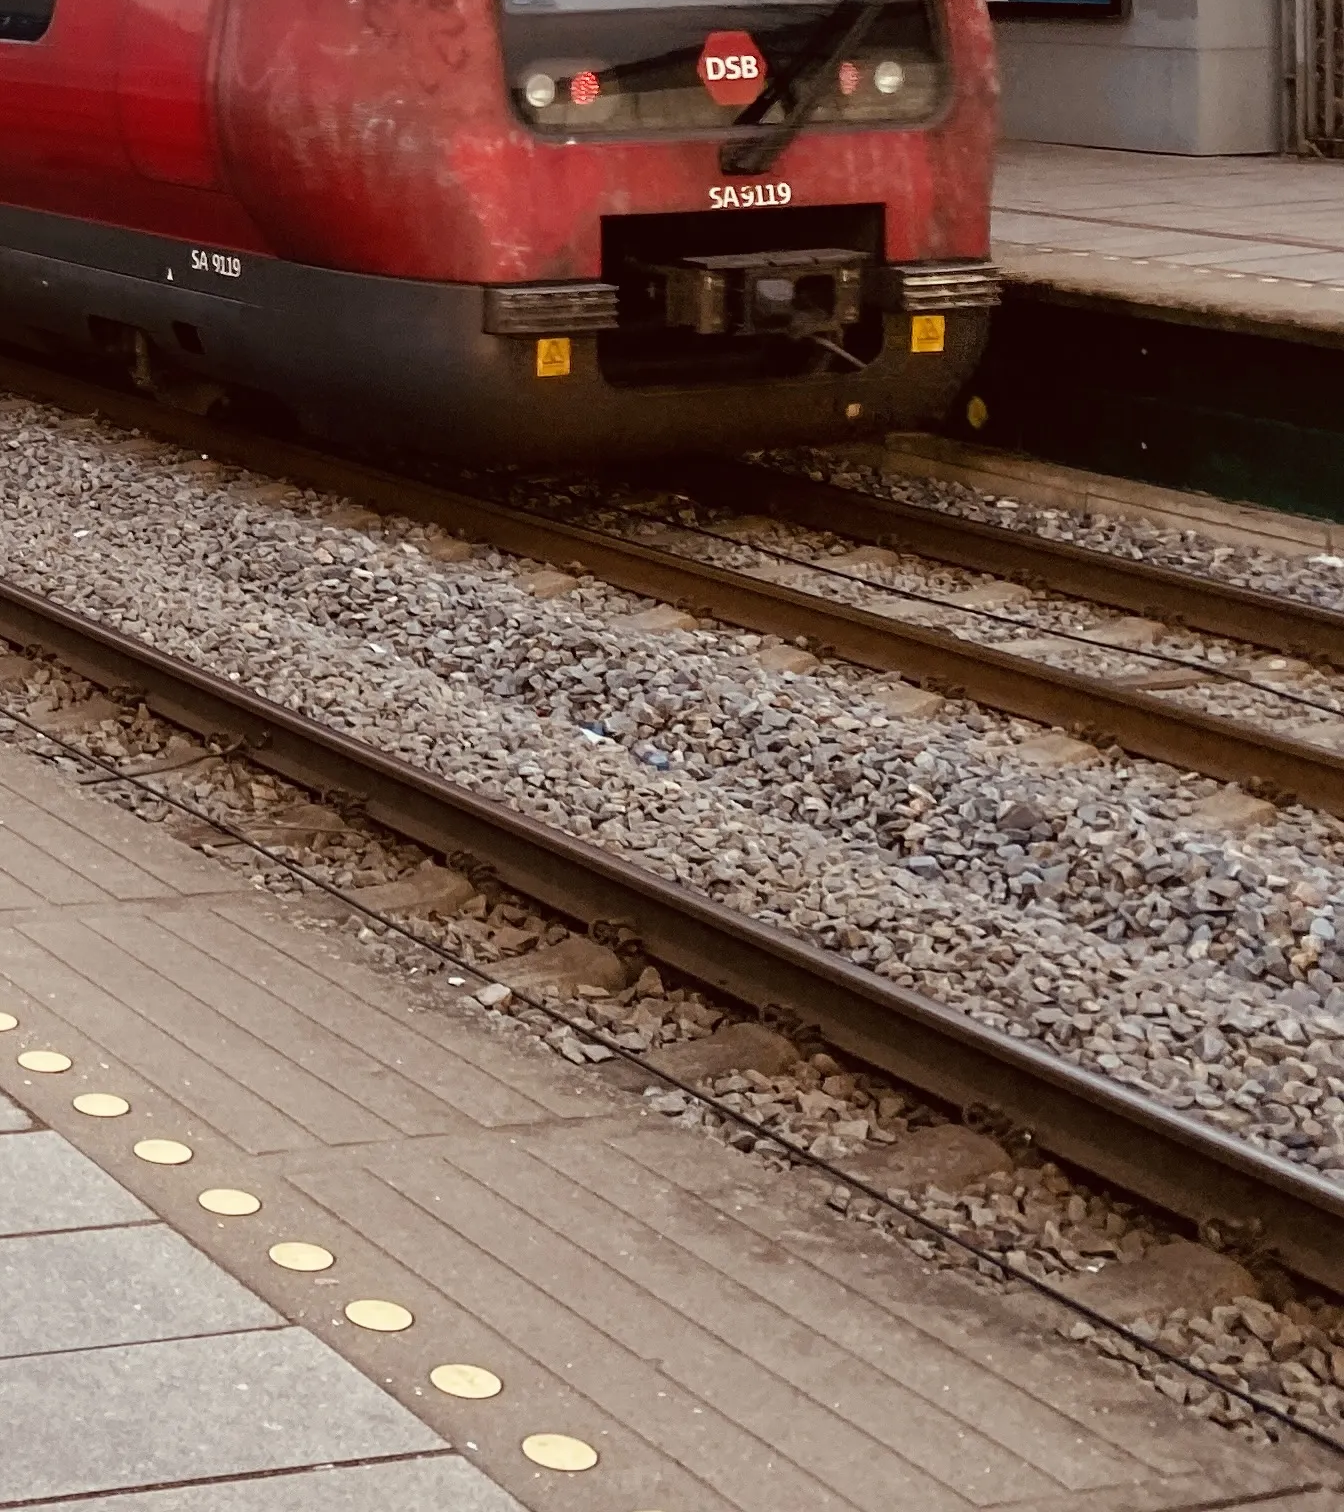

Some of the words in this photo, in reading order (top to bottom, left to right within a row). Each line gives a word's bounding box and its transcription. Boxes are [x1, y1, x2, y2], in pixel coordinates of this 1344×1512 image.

[704, 54, 759, 81] DSB
[191, 249, 209, 272] SA
[211, 253, 242, 278] 9119
